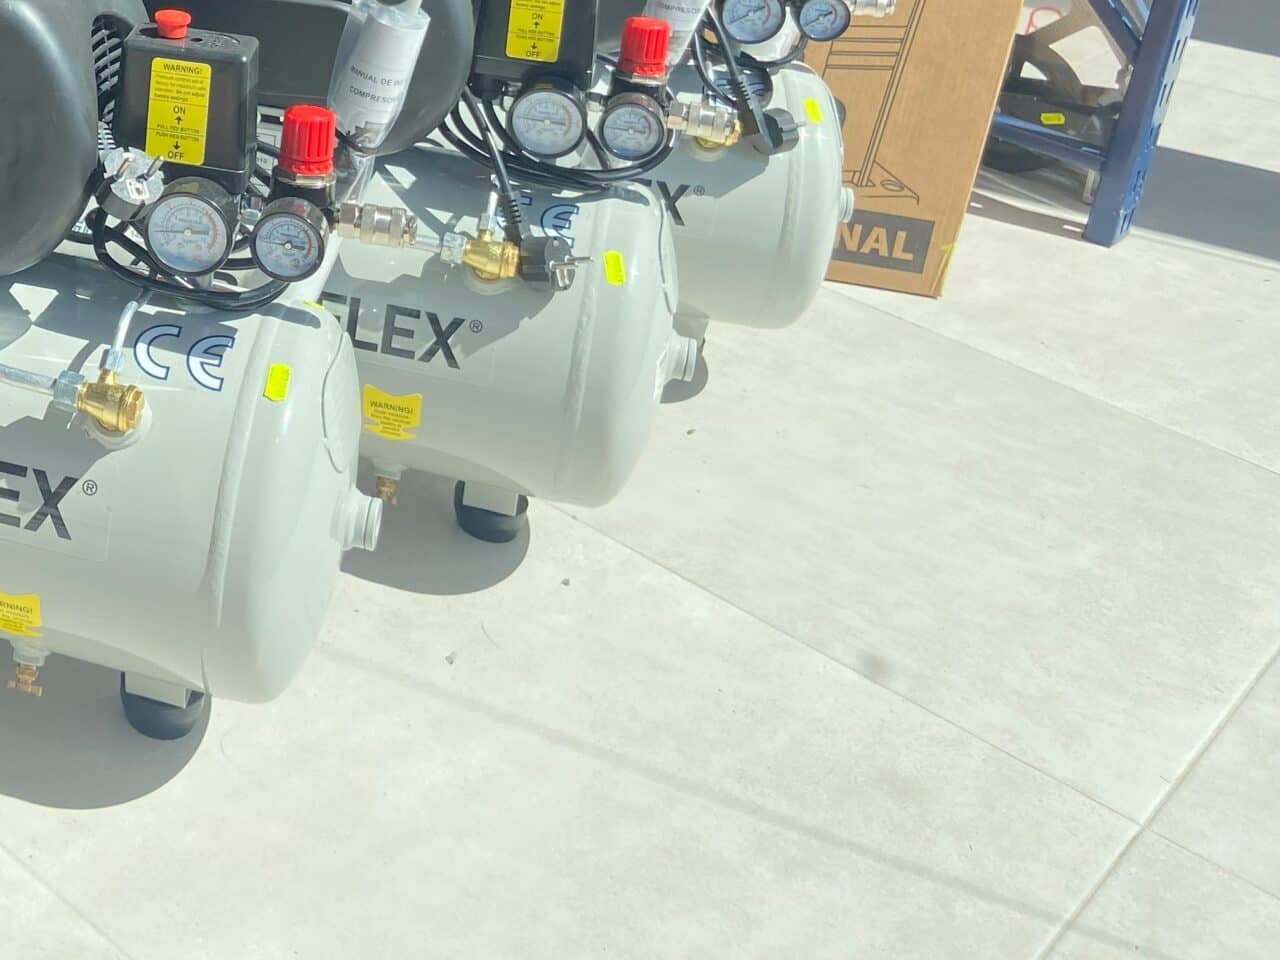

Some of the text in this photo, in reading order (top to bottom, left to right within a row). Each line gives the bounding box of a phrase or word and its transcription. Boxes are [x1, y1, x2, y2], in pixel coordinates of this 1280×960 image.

[173, 105, 186, 115] ON
[167, 151, 185, 161] OFF
[133, 324, 236, 392] CE
